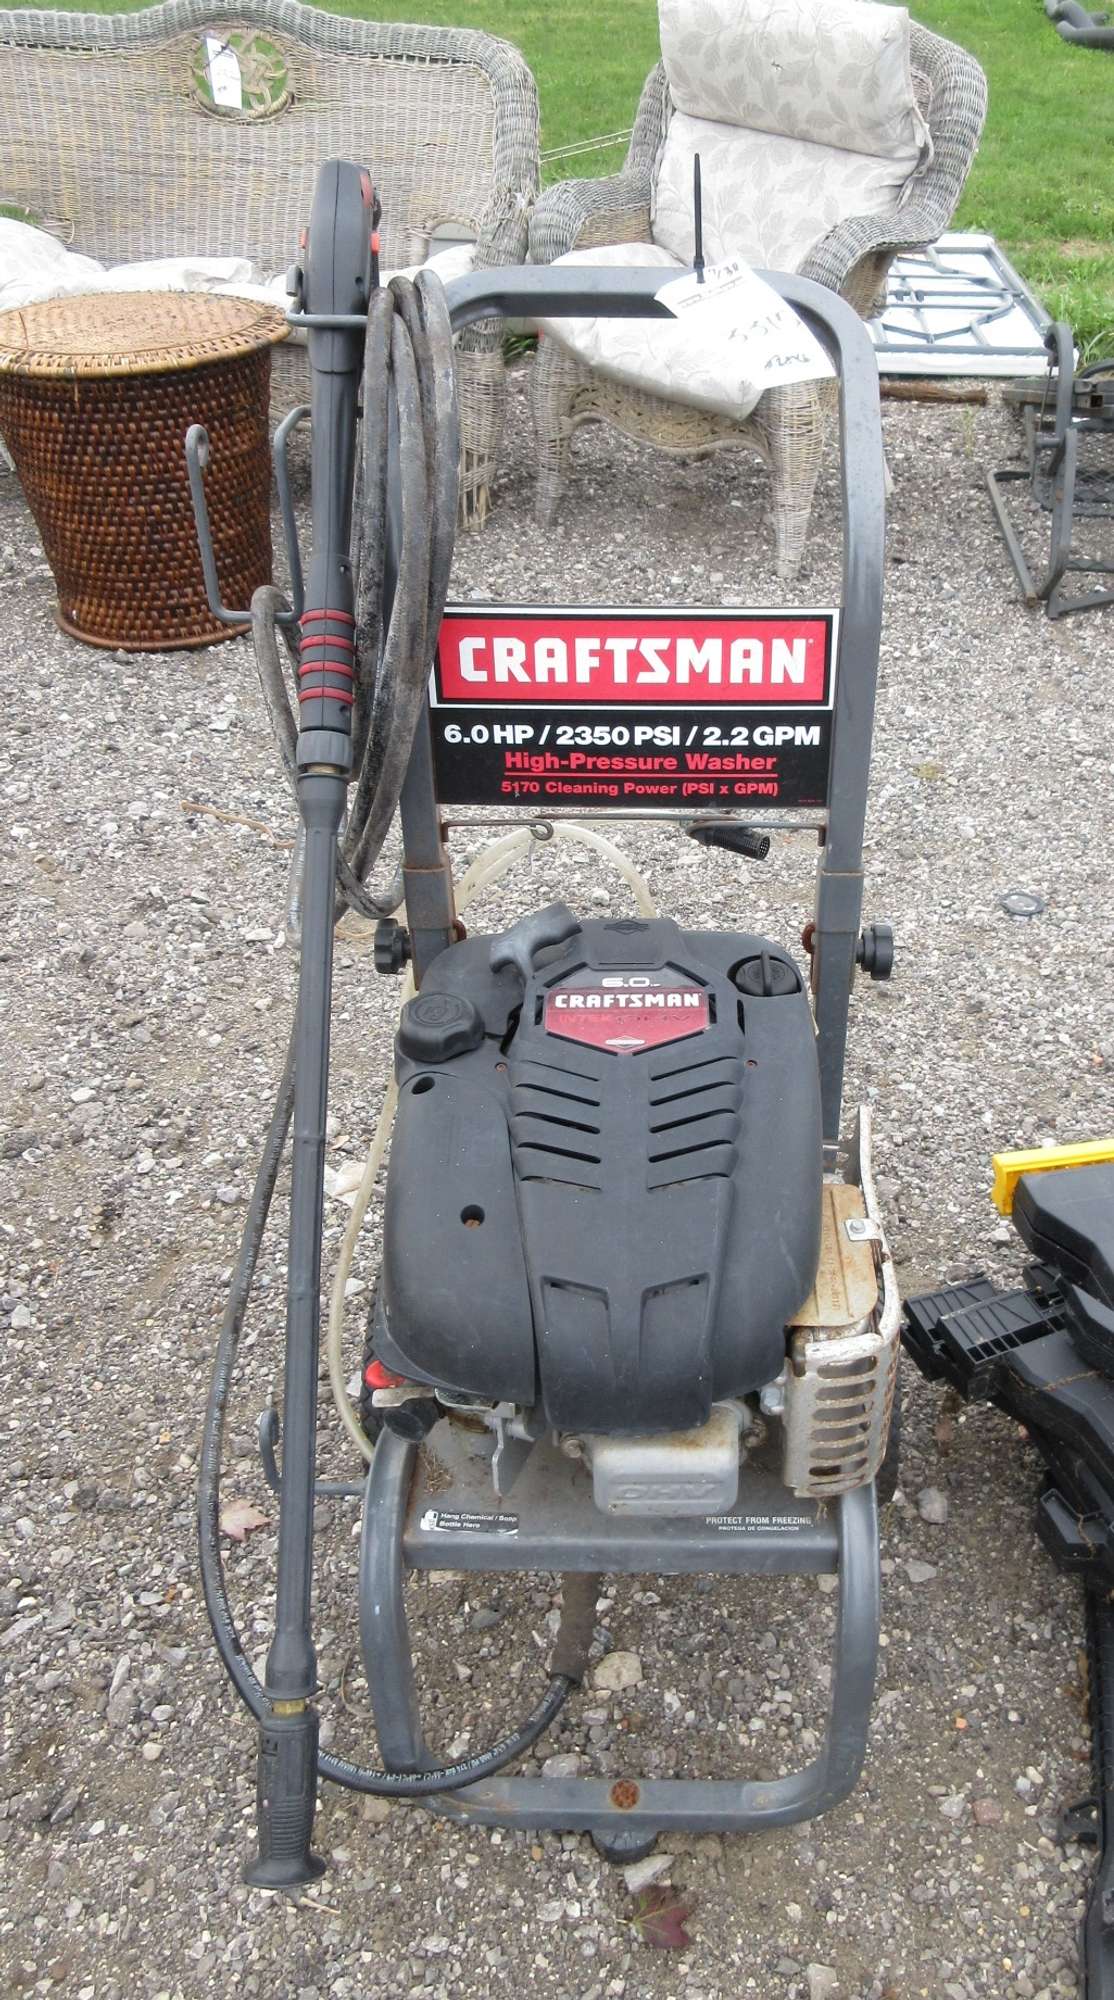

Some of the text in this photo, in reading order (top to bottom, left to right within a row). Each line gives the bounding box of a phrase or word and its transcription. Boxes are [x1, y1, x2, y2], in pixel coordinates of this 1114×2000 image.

[458, 637, 807, 684] CRAFTSMAN
[444, 724, 821, 746] 6.0 HP / 2350 PSI / 2.2 GPM
[504, 751, 777, 773] High-Pressure Washer
[501, 781, 778, 797] 5170 Cleaning Power (PSI x GPM)
[554, 993, 700, 1008] CRAFTSMAN
[705, 1516, 812, 1524] PROTECT FROM FREEZING
